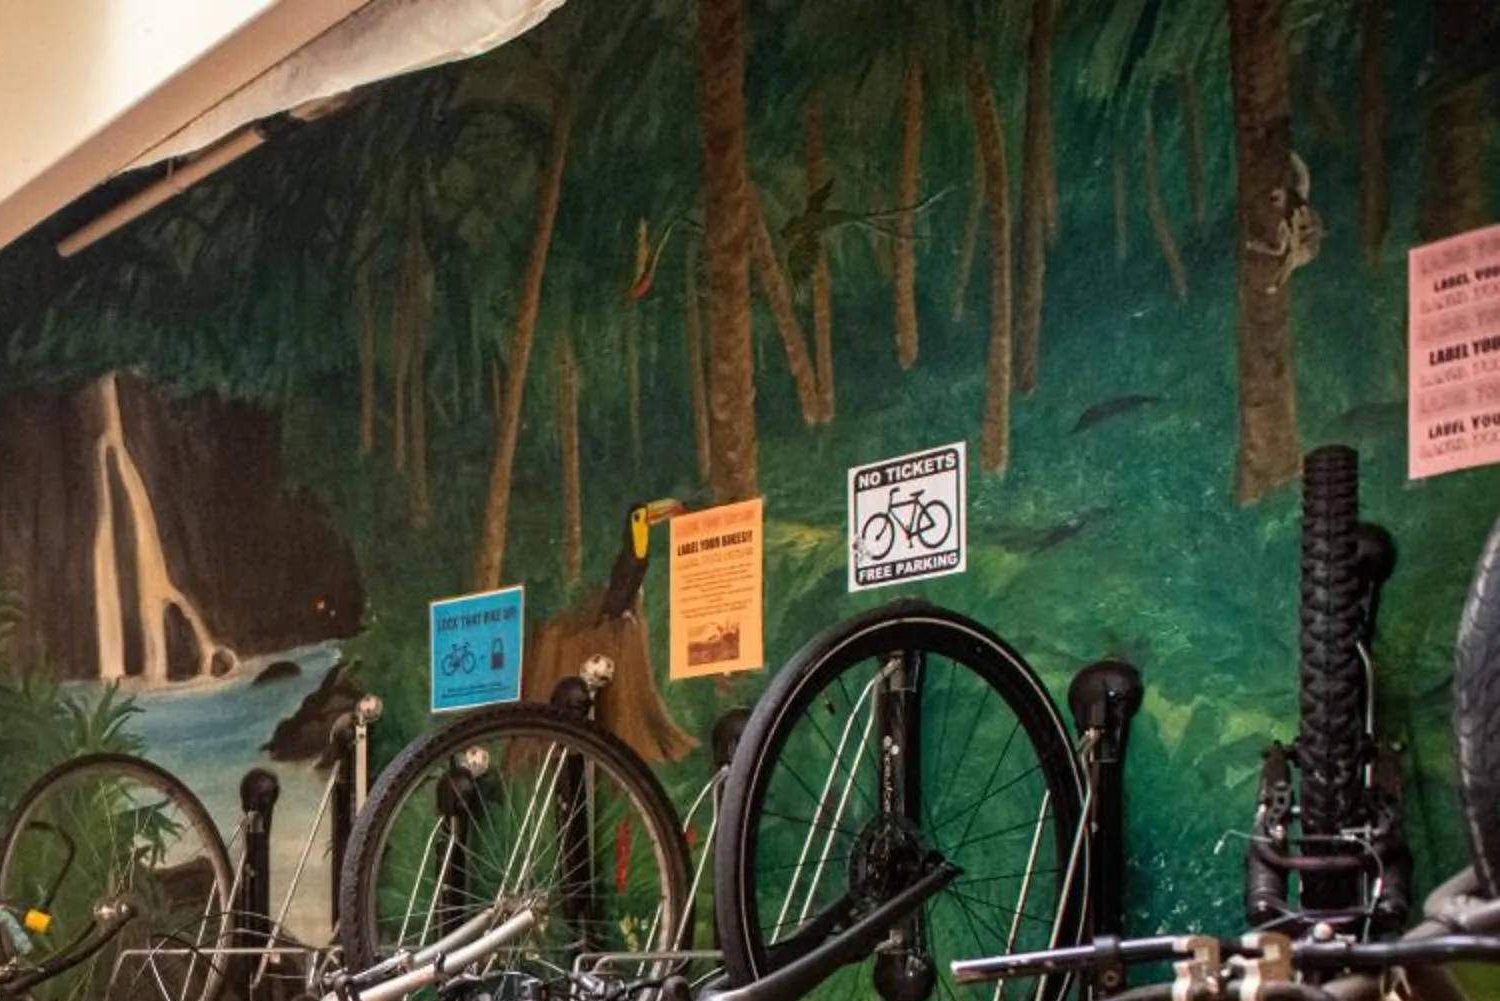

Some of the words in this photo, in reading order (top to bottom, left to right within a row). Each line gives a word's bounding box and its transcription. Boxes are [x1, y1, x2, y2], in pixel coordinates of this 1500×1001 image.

[1433, 273, 1469, 292] LABEL
[1429, 343, 1469, 367] LABEL
[1428, 419, 1465, 440] LABEL
[858, 471, 881, 489] NO
[885, 452, 956, 482] TICKETS
[859, 565, 892, 581] FREE
[895, 552, 957, 575] PARKING
